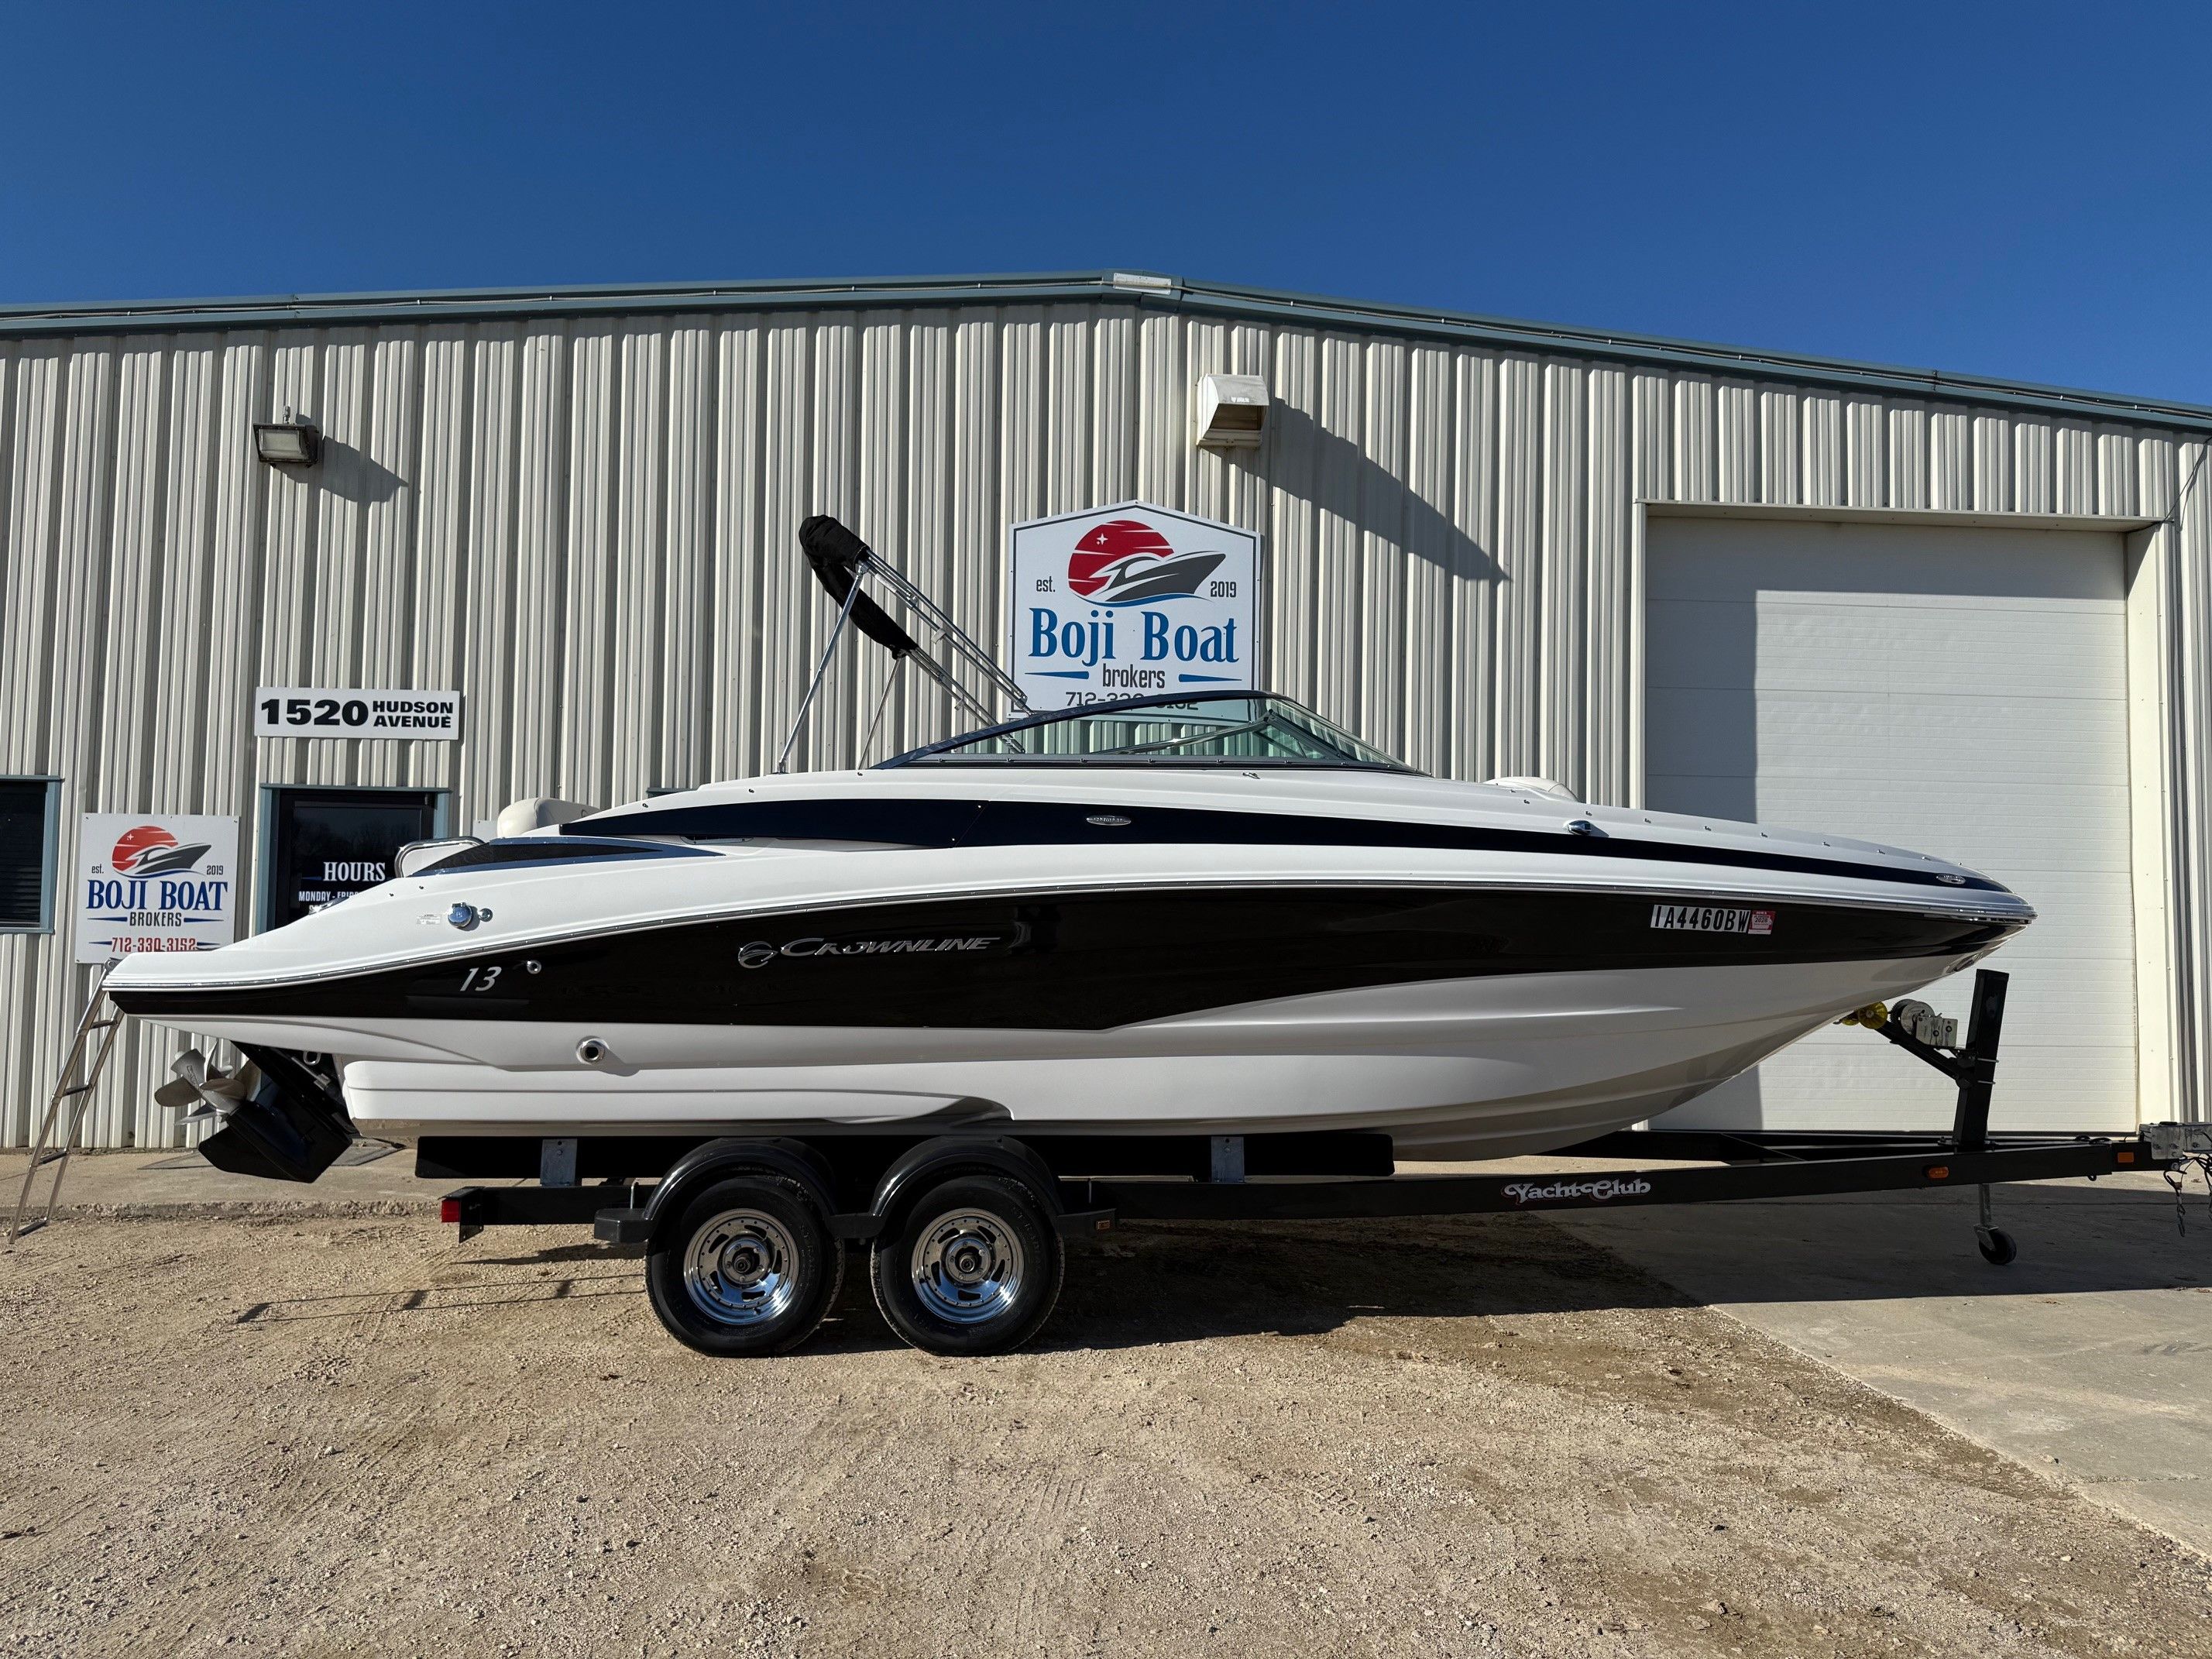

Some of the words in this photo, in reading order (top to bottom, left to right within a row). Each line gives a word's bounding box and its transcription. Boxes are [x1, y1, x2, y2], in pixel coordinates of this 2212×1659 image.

[1036, 575, 1056, 592] est.
[1210, 581, 1237, 598] 2019
[1028, 607, 1117, 668] Boji
[1139, 611, 1240, 663] Boat
[1102, 664, 1166, 689] brokers
[261, 699, 369, 726] 1520
[373, 700, 454, 714] HUDSON
[373, 715, 452, 728] AVENUE
[91, 864, 104, 874] est.
[206, 865, 224, 875] 2019
[323, 861, 386, 881] HOURS
[86, 879, 149, 909] BOJI
[158, 880, 228, 911] BOAT
[298, 891, 331, 902] MONDAY
[129, 912, 182, 927] BROKERS
[1654, 905, 1750, 932] IA4460BW
[112, 937, 196, 953] 712-330-3152
[780, 937, 1001, 957] CROWNLINE
[460, 966, 502, 991] 13
[1504, 1182, 1582, 1204] Yacht
[1578, 1179, 1651, 1200] Club
